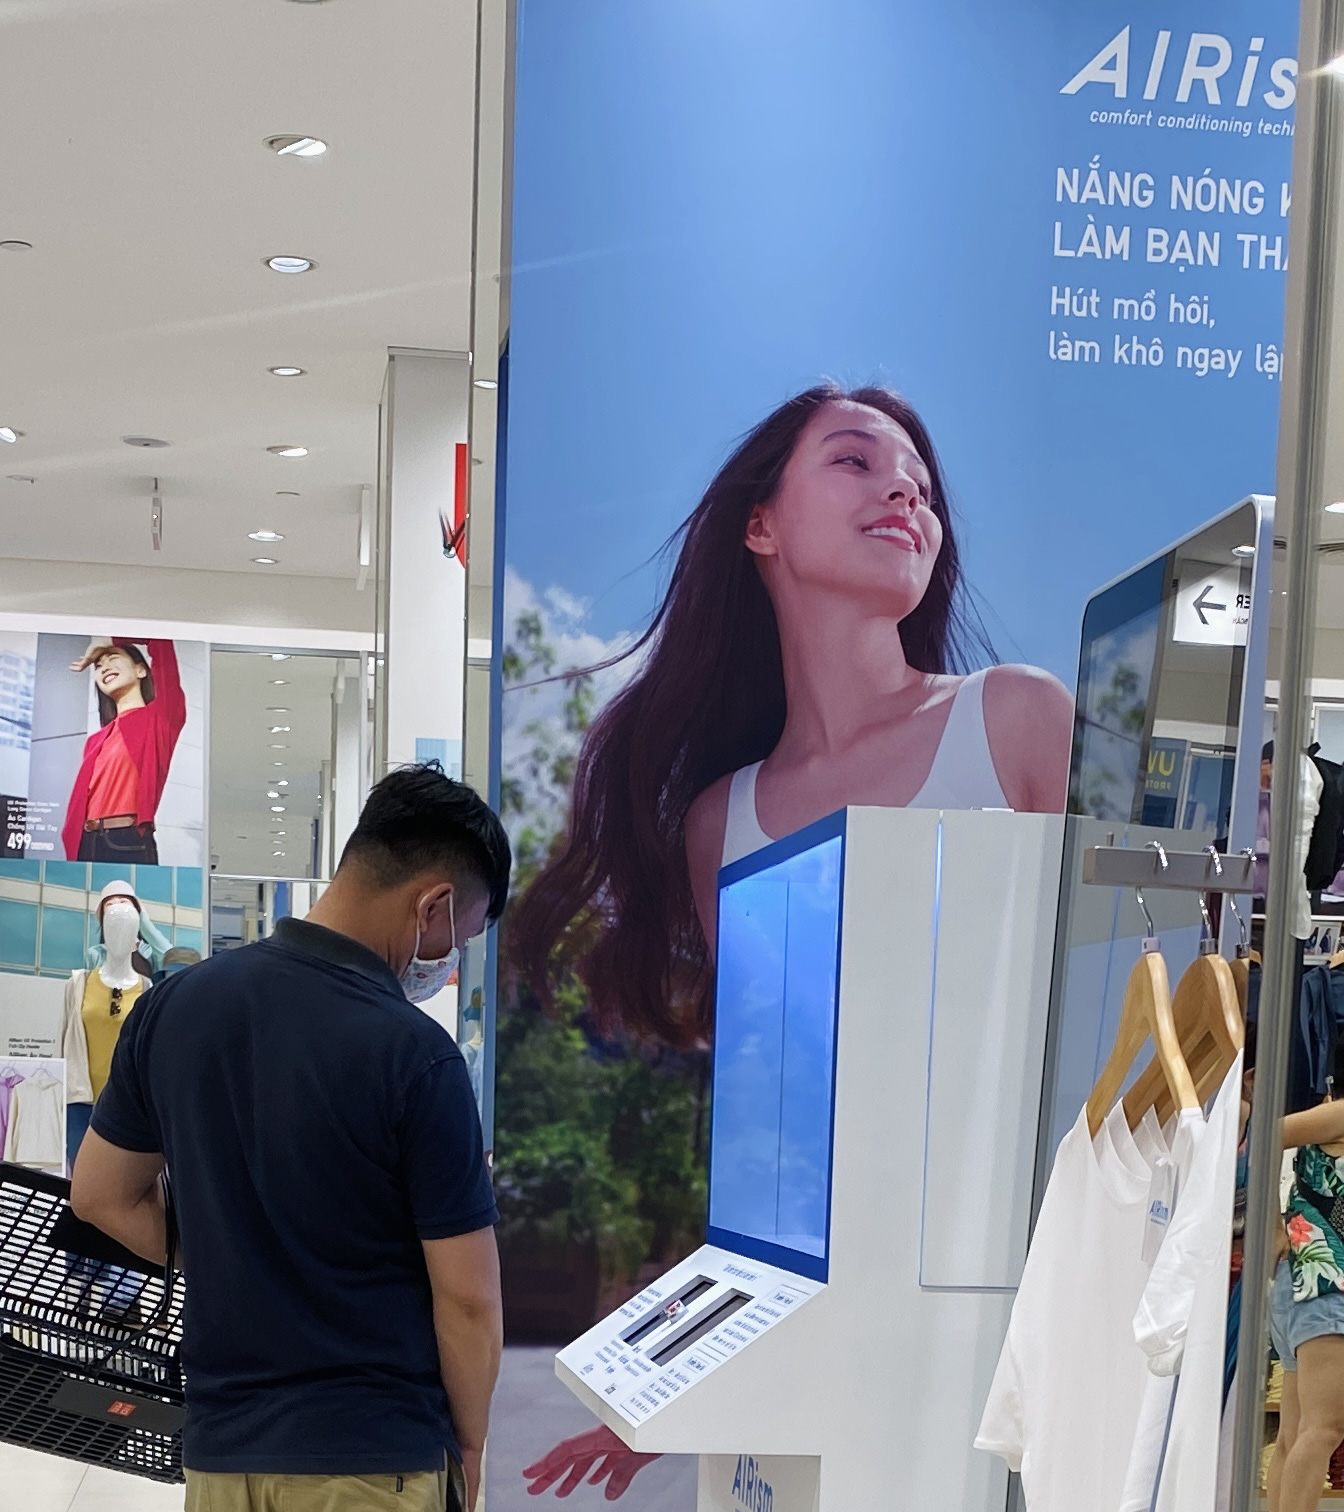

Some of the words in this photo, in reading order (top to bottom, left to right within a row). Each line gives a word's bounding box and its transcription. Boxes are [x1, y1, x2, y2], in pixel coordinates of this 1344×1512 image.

[1059, 24, 1298, 110] AIRis
[1089, 109, 1152, 127] comfort
[1157, 113, 1252, 138] conditioning
[1056, 154, 1155, 208] NẮNG
[1170, 167, 1265, 216] NÓNG
[1053, 213, 1131, 261] LÀM
[1146, 227, 1221, 273] BẠN
[1236, 233, 1289, 271] TH
[1051, 285, 1101, 318] Hút
[1113, 288, 1156, 322] mồ
[1169, 293, 1216, 329] hôi,
[1049, 330, 1101, 363] làm
[1113, 334, 1164, 366] khô
[1176, 345, 1243, 379] ngay
[7, 832, 31, 850] 499
